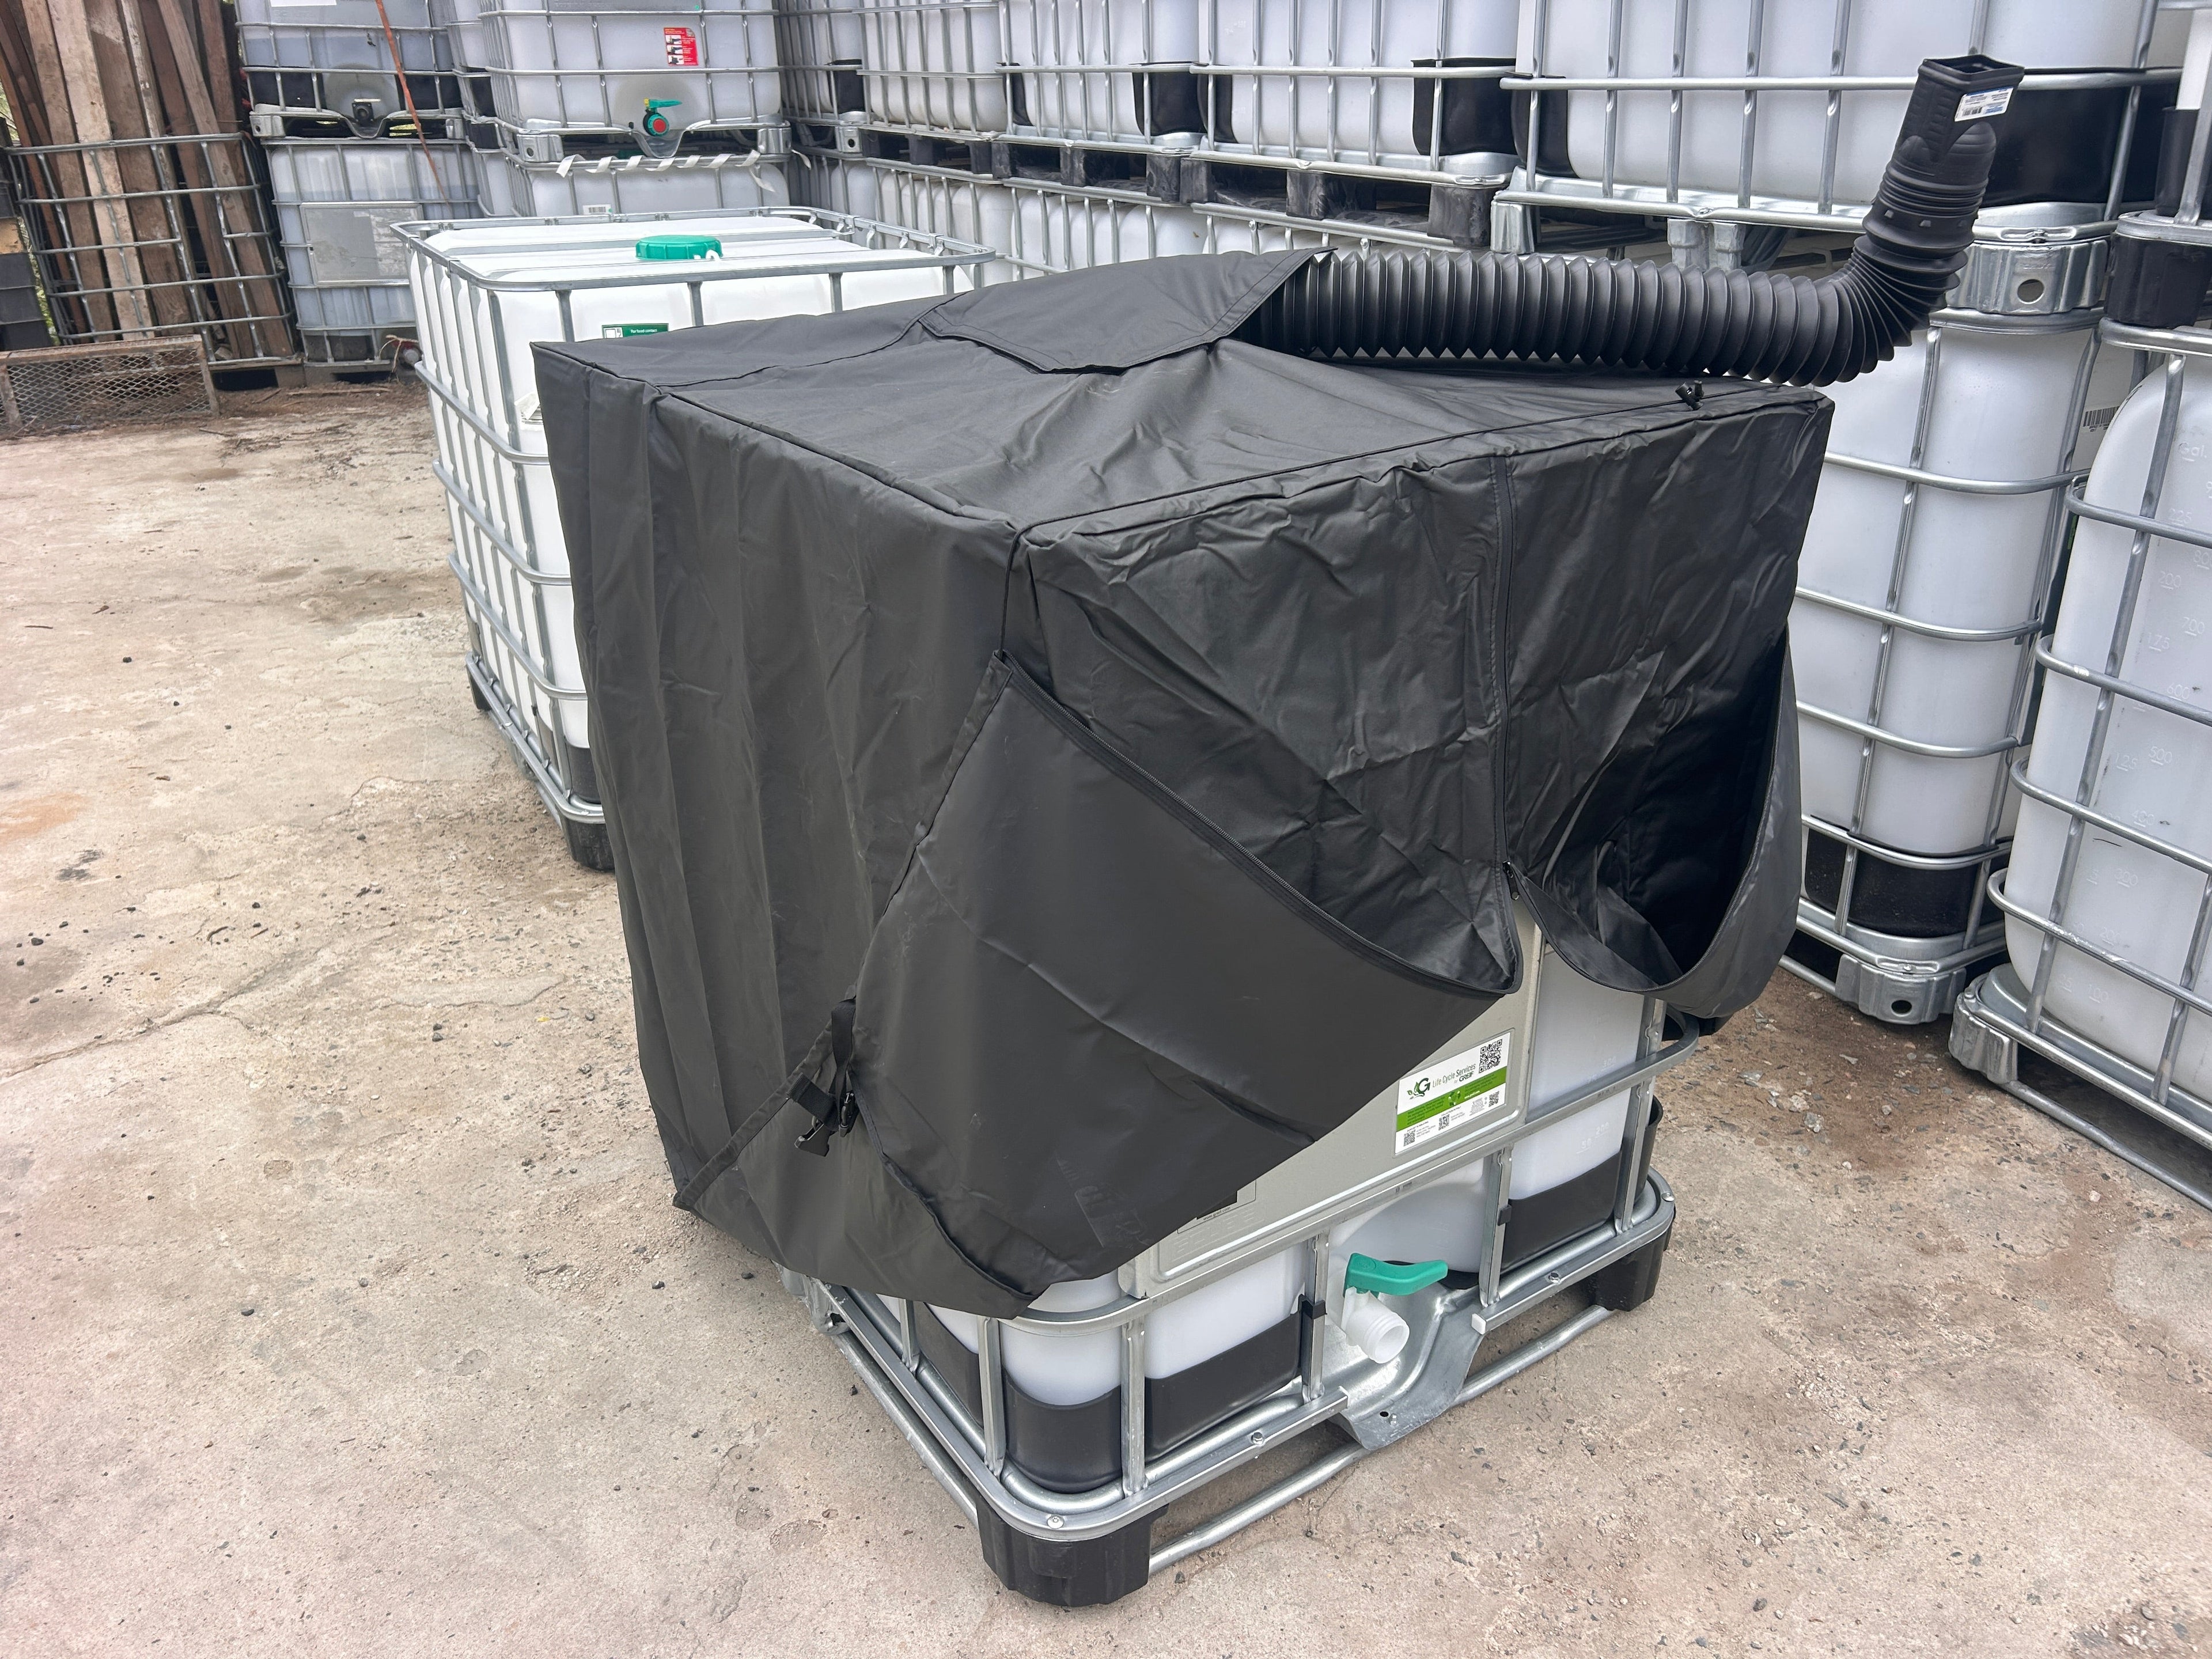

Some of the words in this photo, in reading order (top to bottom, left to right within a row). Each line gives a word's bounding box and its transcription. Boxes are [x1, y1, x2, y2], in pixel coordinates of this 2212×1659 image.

[1433, 1078, 1442, 1088] Life
[1442, 1073, 1456, 1084] Cycle
[1456, 1063, 1476, 1077] Services
